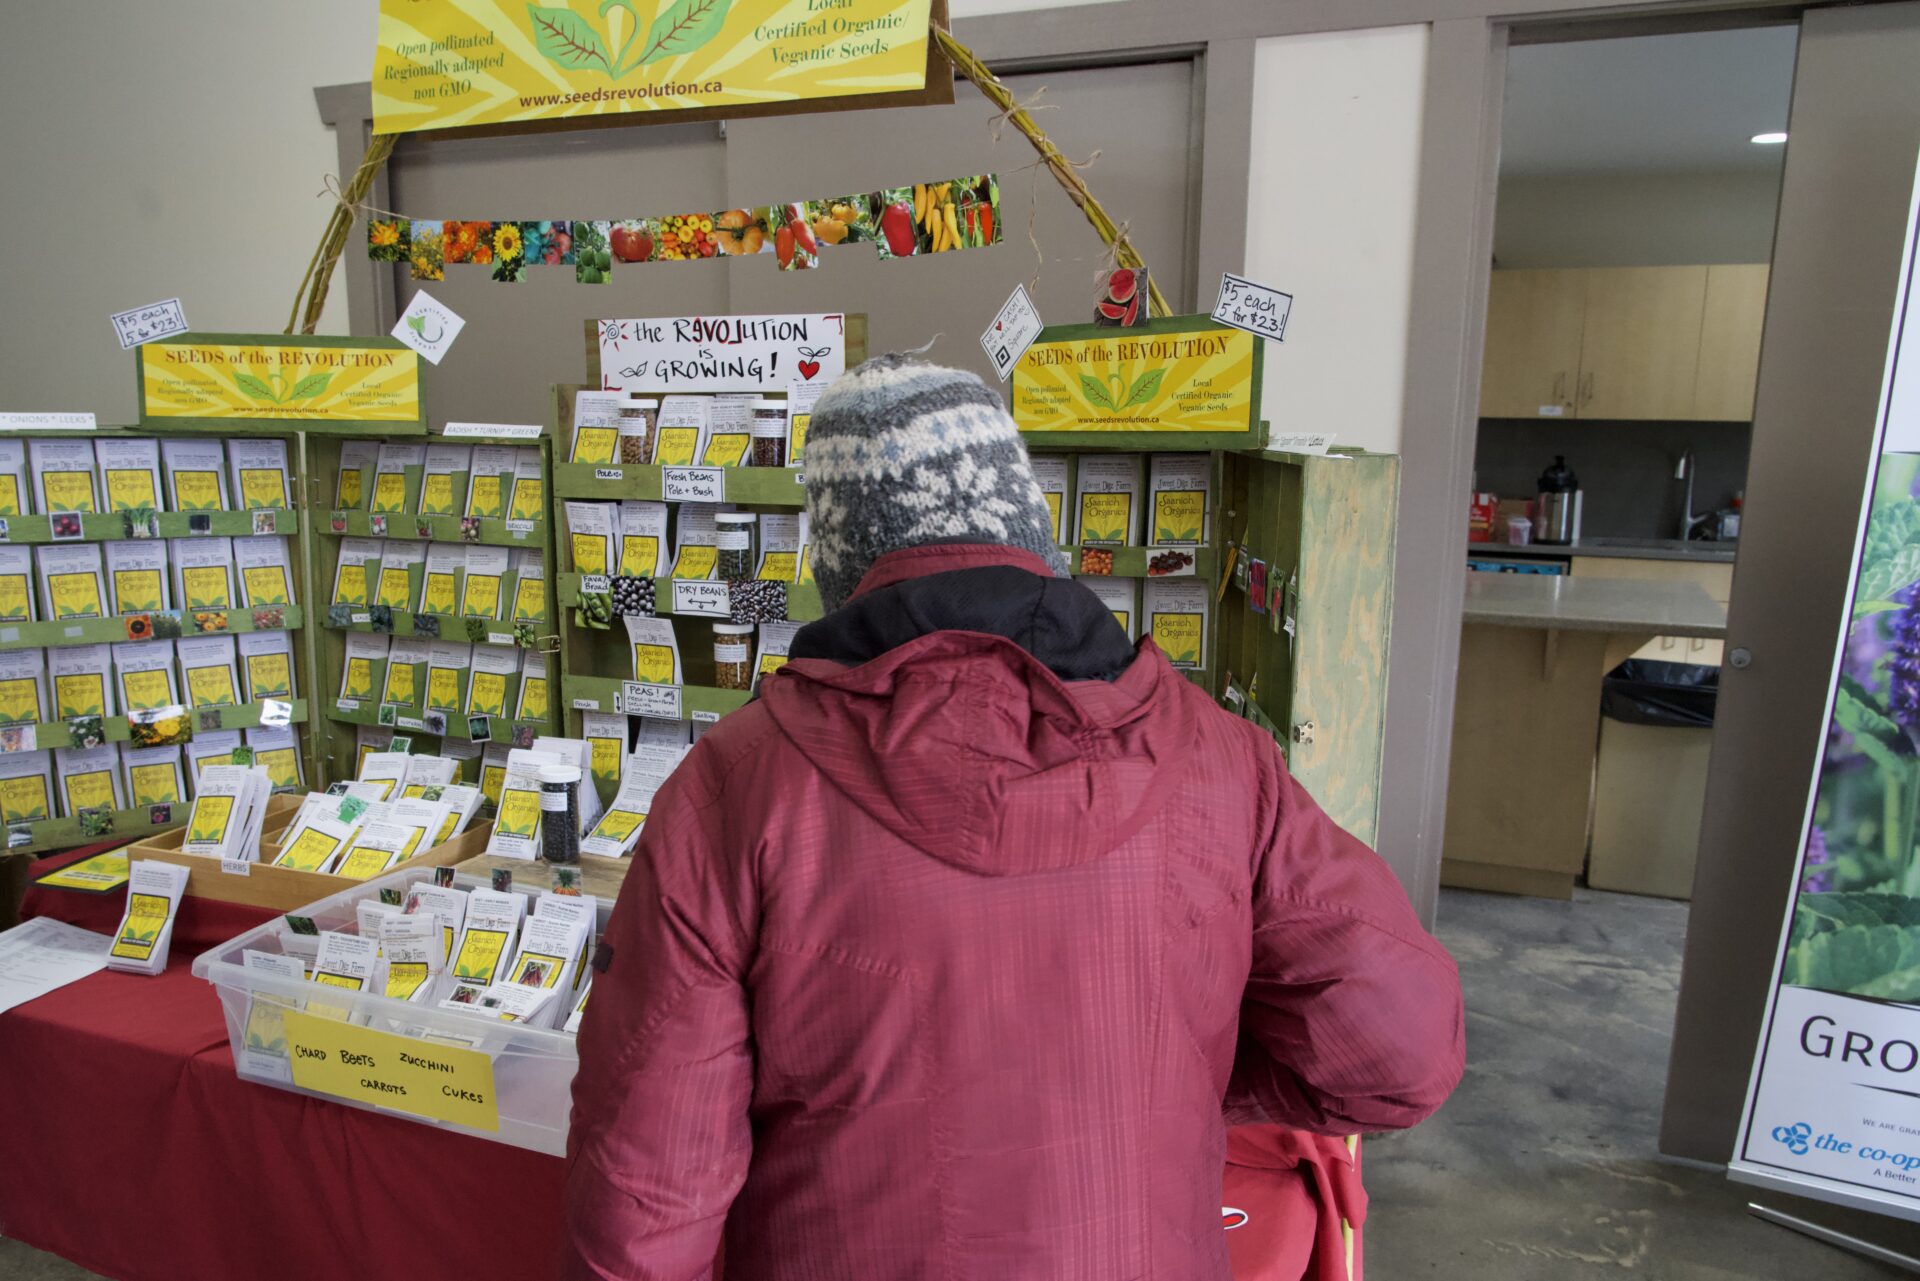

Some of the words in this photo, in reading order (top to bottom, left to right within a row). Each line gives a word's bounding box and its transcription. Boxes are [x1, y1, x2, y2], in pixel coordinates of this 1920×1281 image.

[754, 19, 827, 42] Certified
[396, 41, 427, 59] Open
[429, 31, 495, 56] pollinated
[771, 45, 835, 67] Veganic
[840, 38, 889, 59] Seeds
[384, 59, 450, 83] Regionally
[452, 53, 505, 74] adapted
[413, 87, 436, 100] non
[439, 79, 472, 98] GMO
[519, 79, 723, 108] www.seedsrevolution.ca
[1223, 280, 1249, 300] $5
[1244, 293, 1276, 312] each
[119, 314, 137, 330] $5
[141, 305, 170, 322] each
[1217, 304, 1229, 318] 5
[1231, 306, 1248, 324] for
[1250, 312, 1285, 332] $23!
[126, 332, 136, 345] 5
[634, 320, 665, 343] the
[164, 349, 225, 366] SEEDS
[229, 350, 244, 365] of
[249, 350, 273, 366] the
[279, 351, 395, 368] REVOLUTION
[698, 345, 712, 359] is
[1028, 345, 1073, 367] SEEDS
[1076, 344, 1092, 363] of
[1093, 344, 1113, 363] the
[1117, 336, 1229, 361] REVOLUTION
[362, 381, 381, 390] Local
[1192, 378, 1212, 387] Local
[1171, 391, 1202, 401] Certified
[1204, 390, 1233, 401] Organic
[1178, 403, 1205, 413] Veganic
[1207, 402, 1228, 412] Seeds
[1077, 415, 1160, 426] www.seedsrevolution.ca
[666, 471, 687, 482] Fresh
[689, 471, 715, 482] Beans
[668, 484, 683, 496] Pole
[692, 486, 714, 497] Bush
[1158, 494, 1194, 507] Saanich
[1163, 505, 1201, 518] Organics
[678, 585, 698, 595] DRY
[1155, 616, 1192, 629] Saanich
[223, 862, 247, 873] HERBS
[295, 1044, 328, 1061] CHARD
[399, 1052, 455, 1074] ZUCCHINI
[360, 1078, 408, 1096] CARROTS
[1862, 1117, 1876, 1128] WE
[1879, 1122, 1896, 1131] ARE
[1814, 1133, 1853, 1154] the
[1858, 1146, 1920, 1172] co-op
[1873, 1168, 1881, 1177] A
[1885, 1170, 1917, 1184] Better
